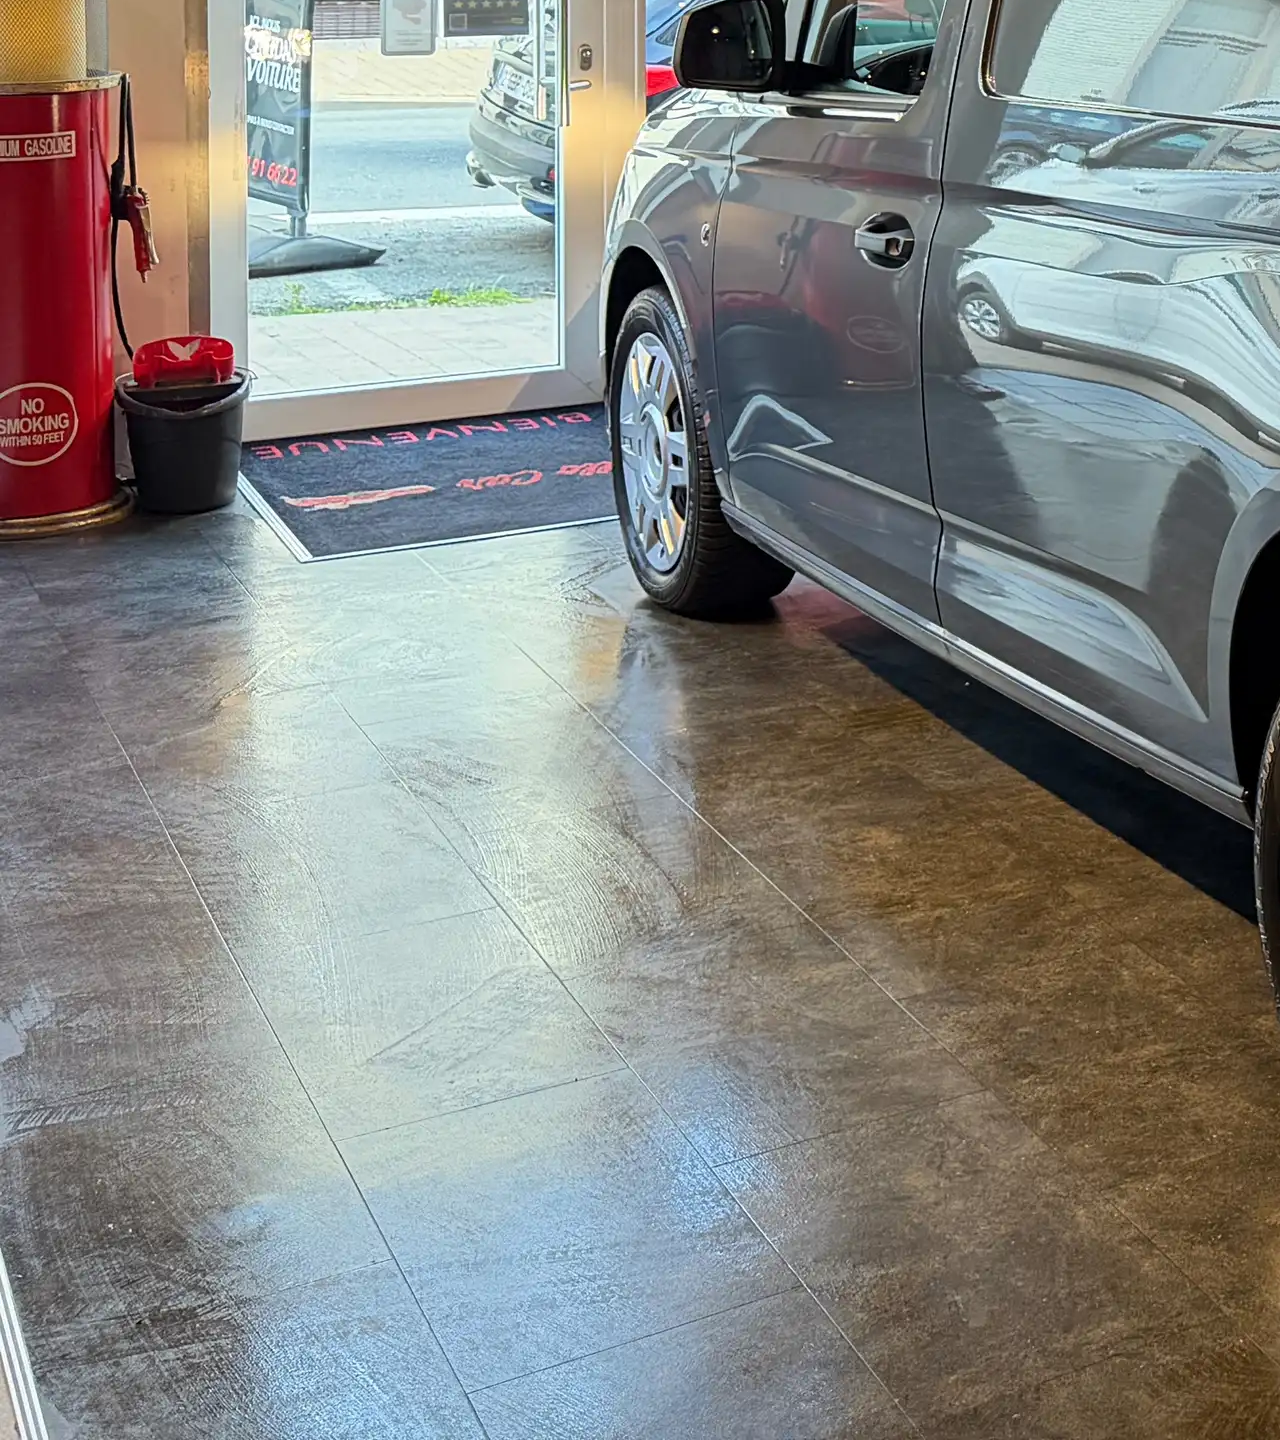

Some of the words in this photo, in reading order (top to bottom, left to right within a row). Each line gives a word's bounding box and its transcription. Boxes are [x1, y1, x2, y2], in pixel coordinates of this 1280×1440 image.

[247, 57, 301, 93] VOITURE
[21, 398, 45, 415] NO
[0, 413, 70, 435] SMOKING
[44, 430, 65, 444] FEET
[251, 412, 592, 460] BIENVENUE
